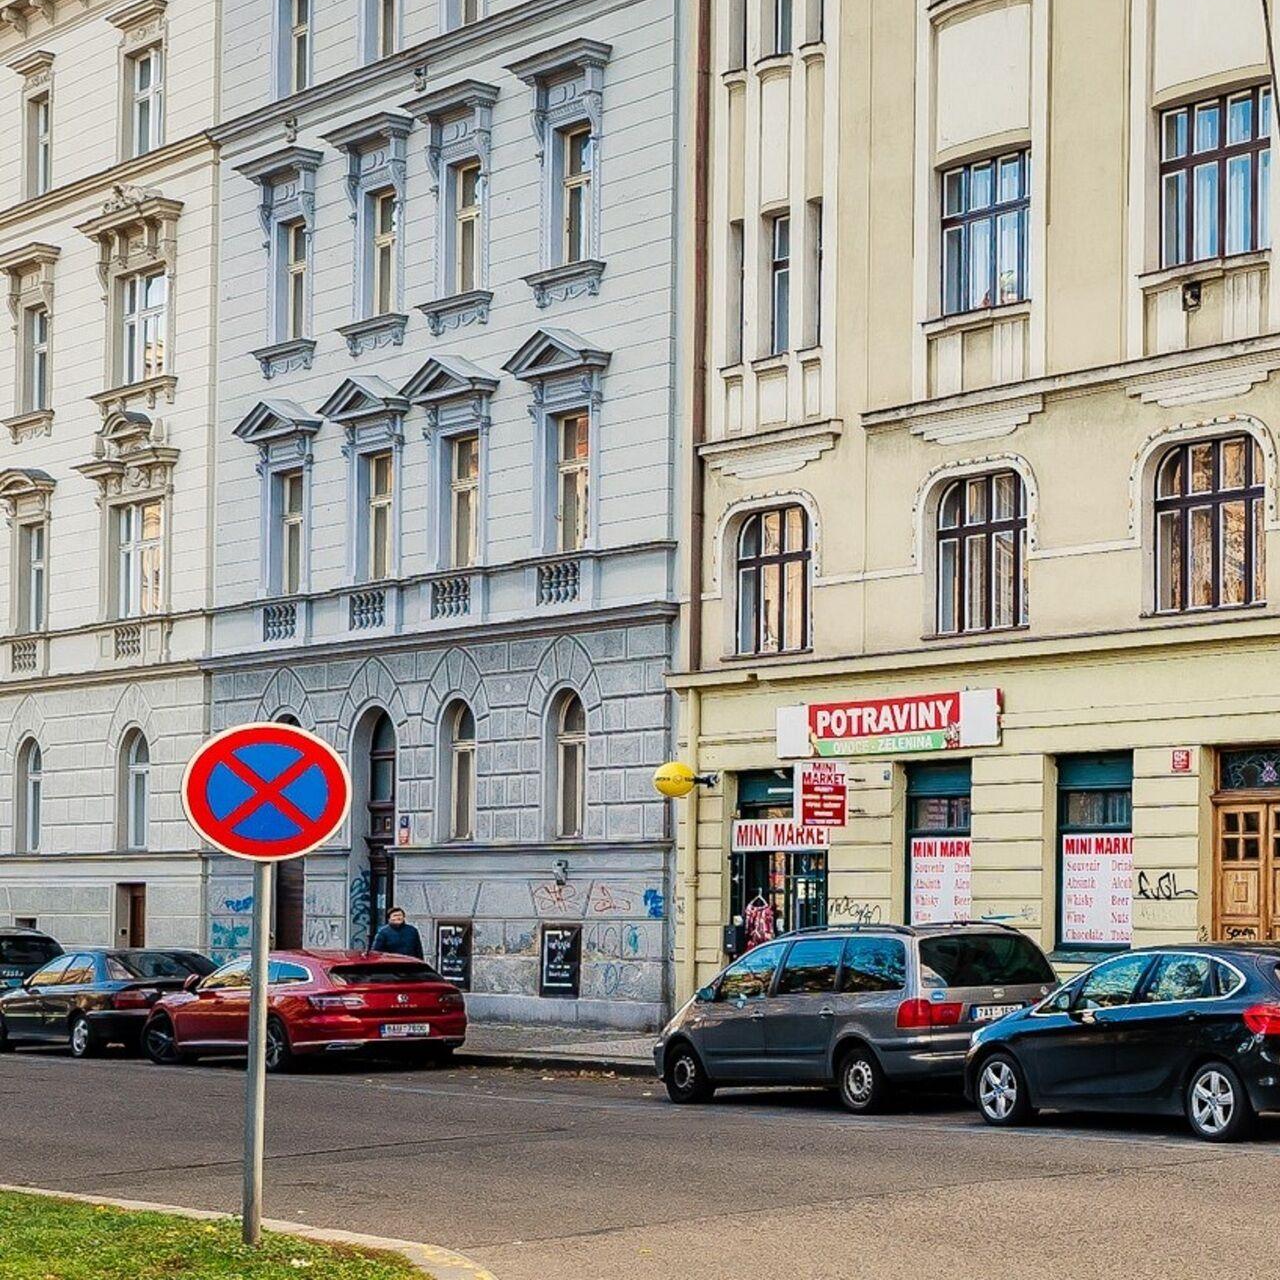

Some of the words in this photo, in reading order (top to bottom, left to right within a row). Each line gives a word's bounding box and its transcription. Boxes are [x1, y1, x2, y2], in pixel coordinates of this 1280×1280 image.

[816, 699, 954, 738] POTRAVINY
[878, 735, 933, 751] ZELENINA
[812, 762, 837, 772] MINI
[802, 771, 846, 785] MARKET
[736, 824, 769, 847] MINI
[913, 841, 937, 858] MINI
[1064, 837, 1092, 855] MINI
[1066, 859, 1101, 872] Souvenir
[1066, 894, 1094, 908] Whisky
[1110, 894, 1130, 906] Beer
